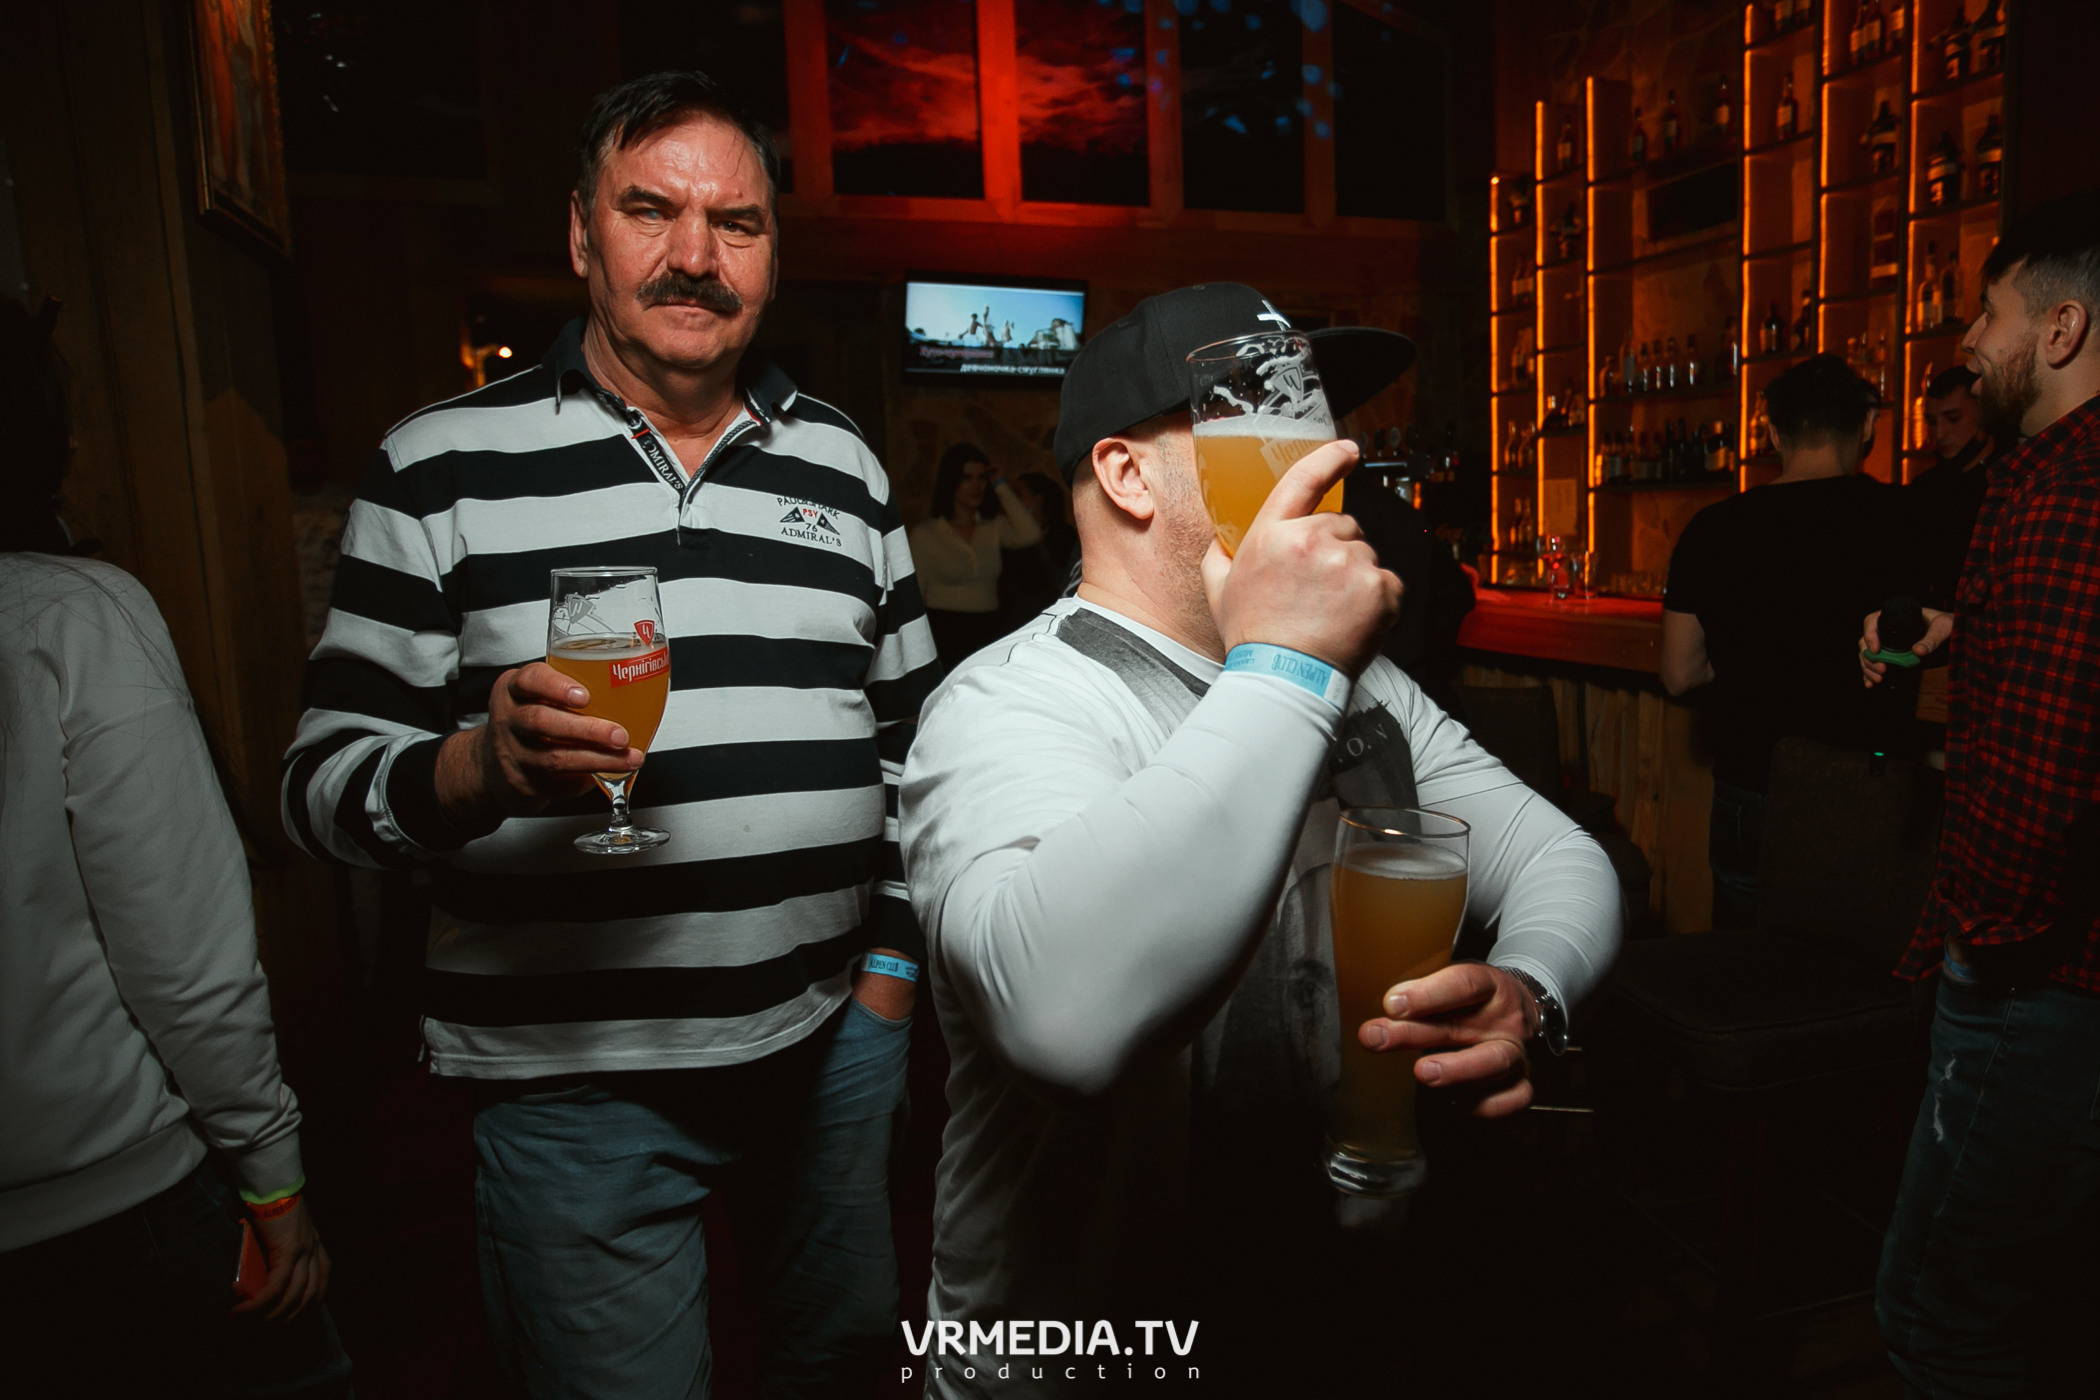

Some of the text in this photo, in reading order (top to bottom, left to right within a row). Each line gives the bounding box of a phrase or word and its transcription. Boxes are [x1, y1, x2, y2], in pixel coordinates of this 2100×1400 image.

[802, 508, 818, 519] PSY
[805, 523, 818, 533] 76
[781, 527, 842, 547] ADMIRAL'S
